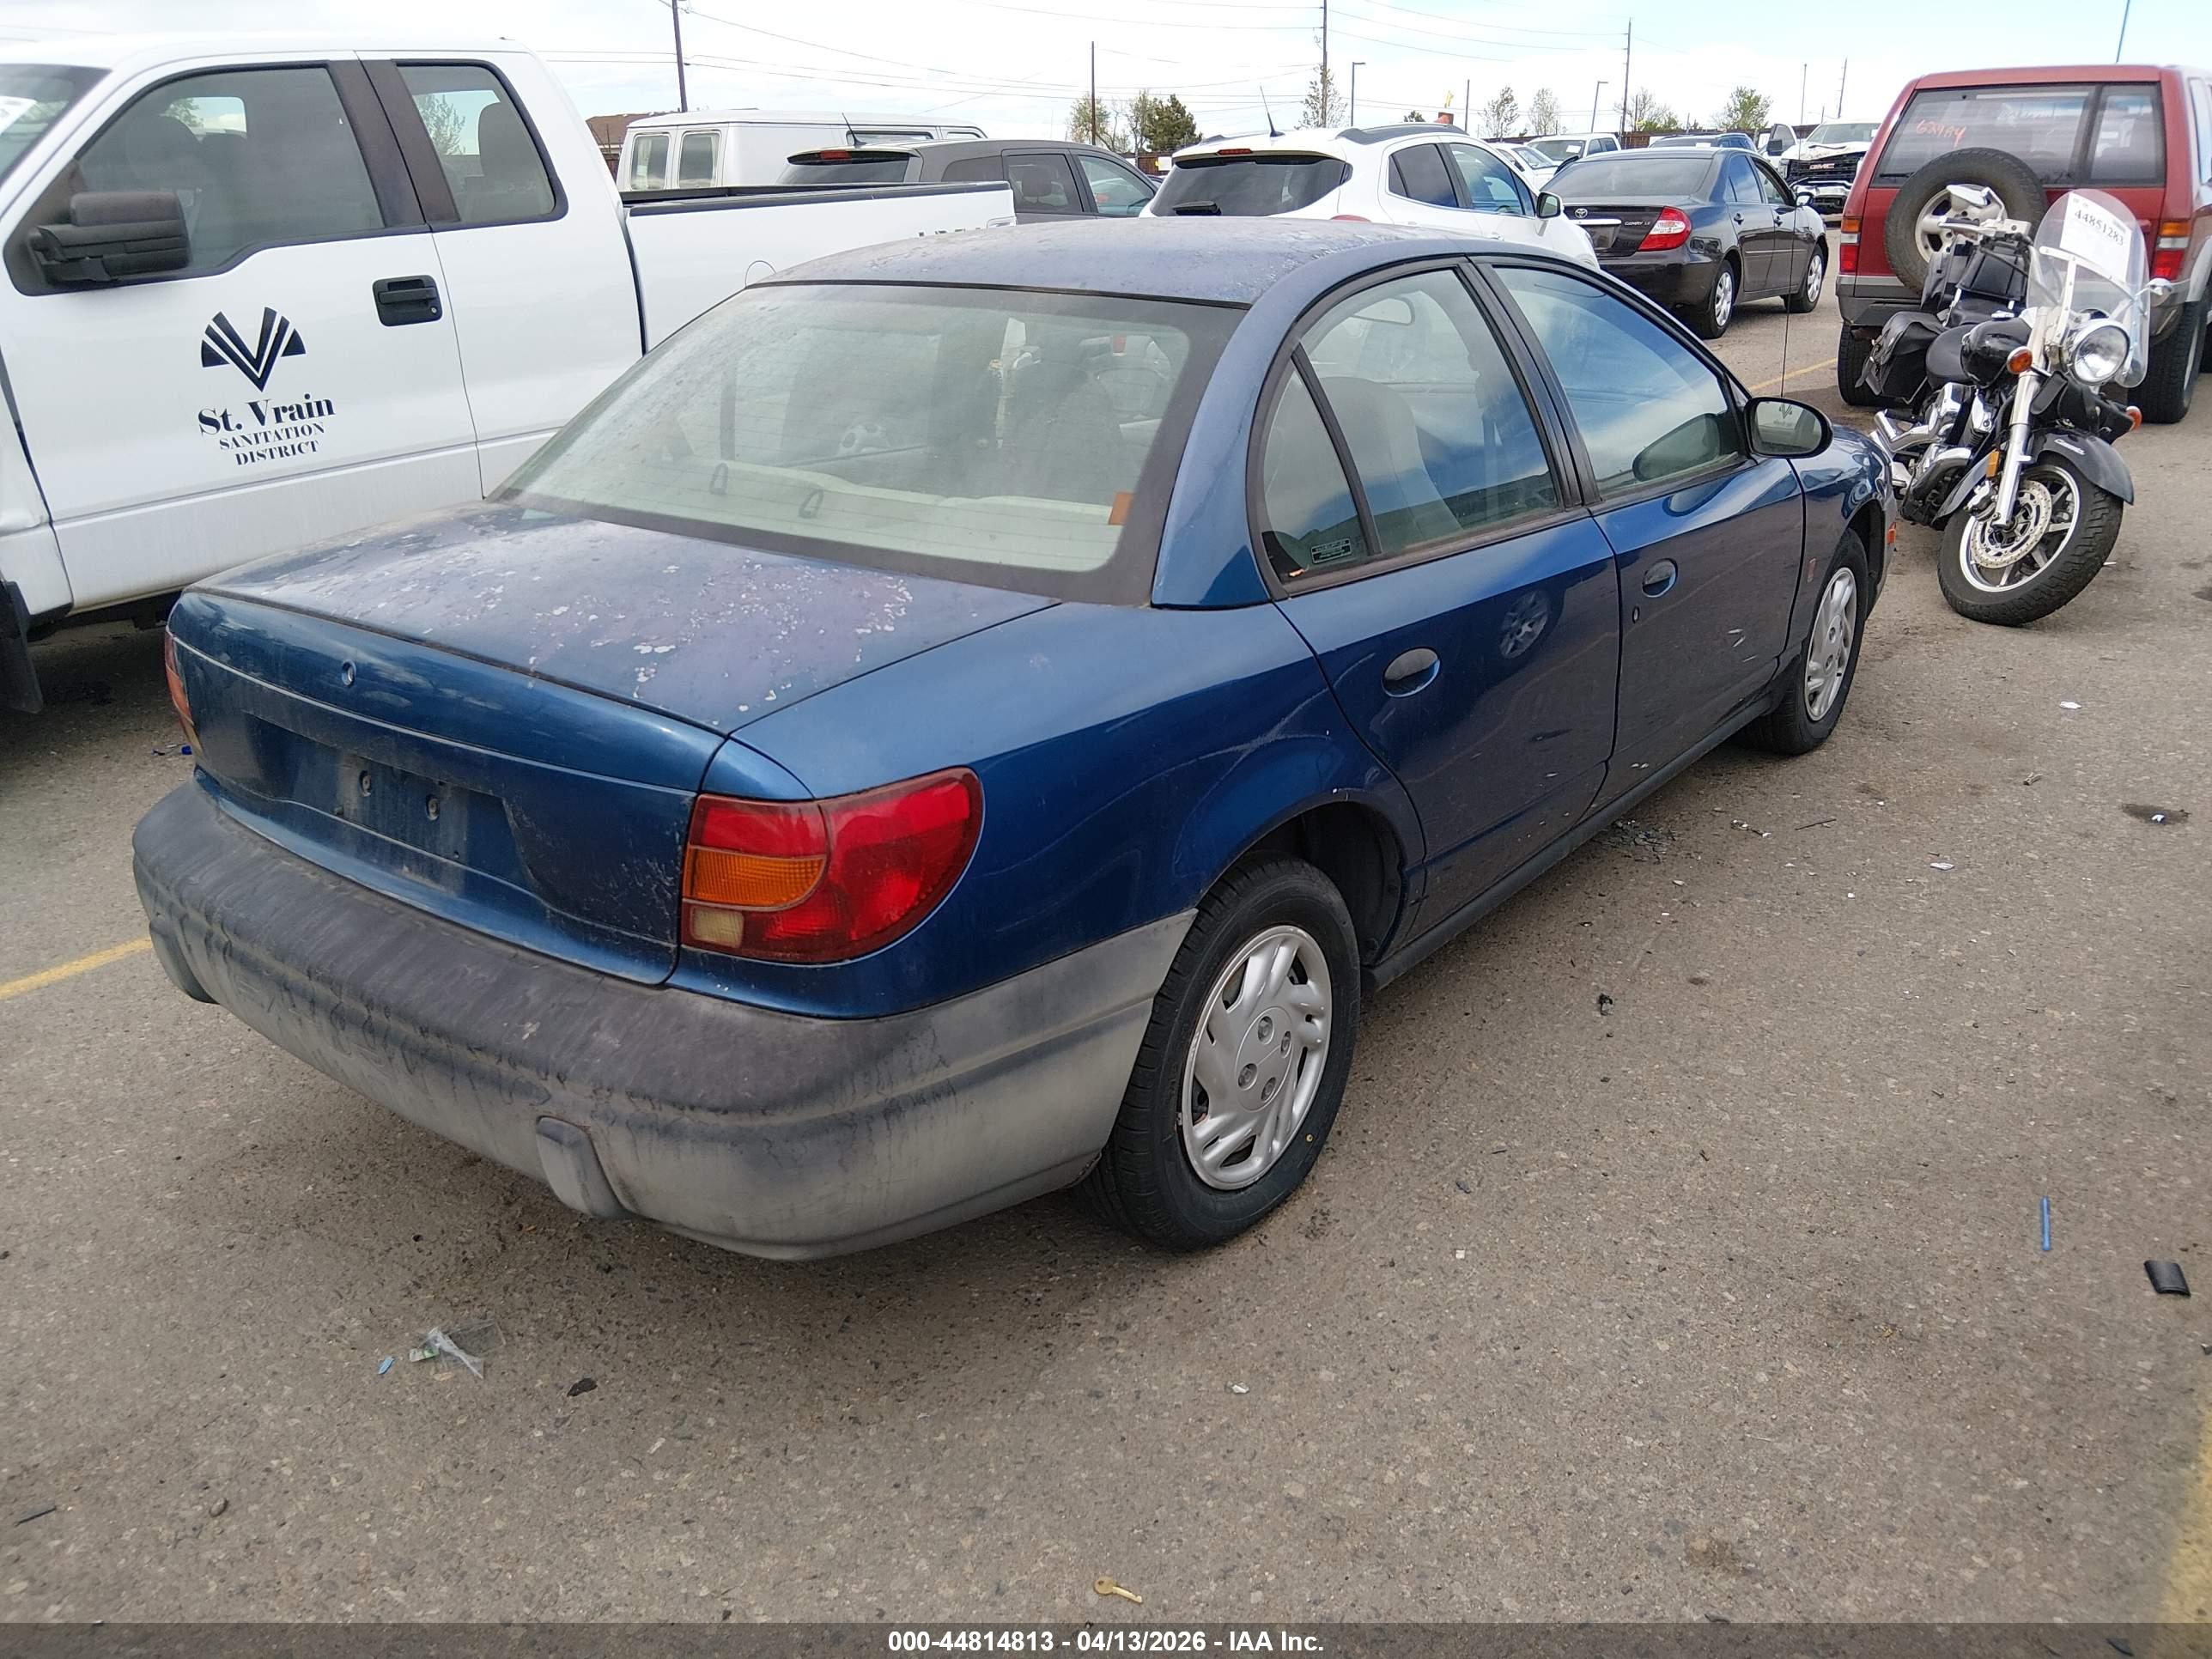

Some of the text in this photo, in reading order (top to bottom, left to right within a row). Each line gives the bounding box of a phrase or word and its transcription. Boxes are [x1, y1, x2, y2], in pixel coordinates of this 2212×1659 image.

[2075, 210, 2124, 246] 44851283
[198, 392, 337, 436] St. Vrain
[219, 421, 325, 450] SANITATION
[234, 440, 320, 465] DISTRICT
